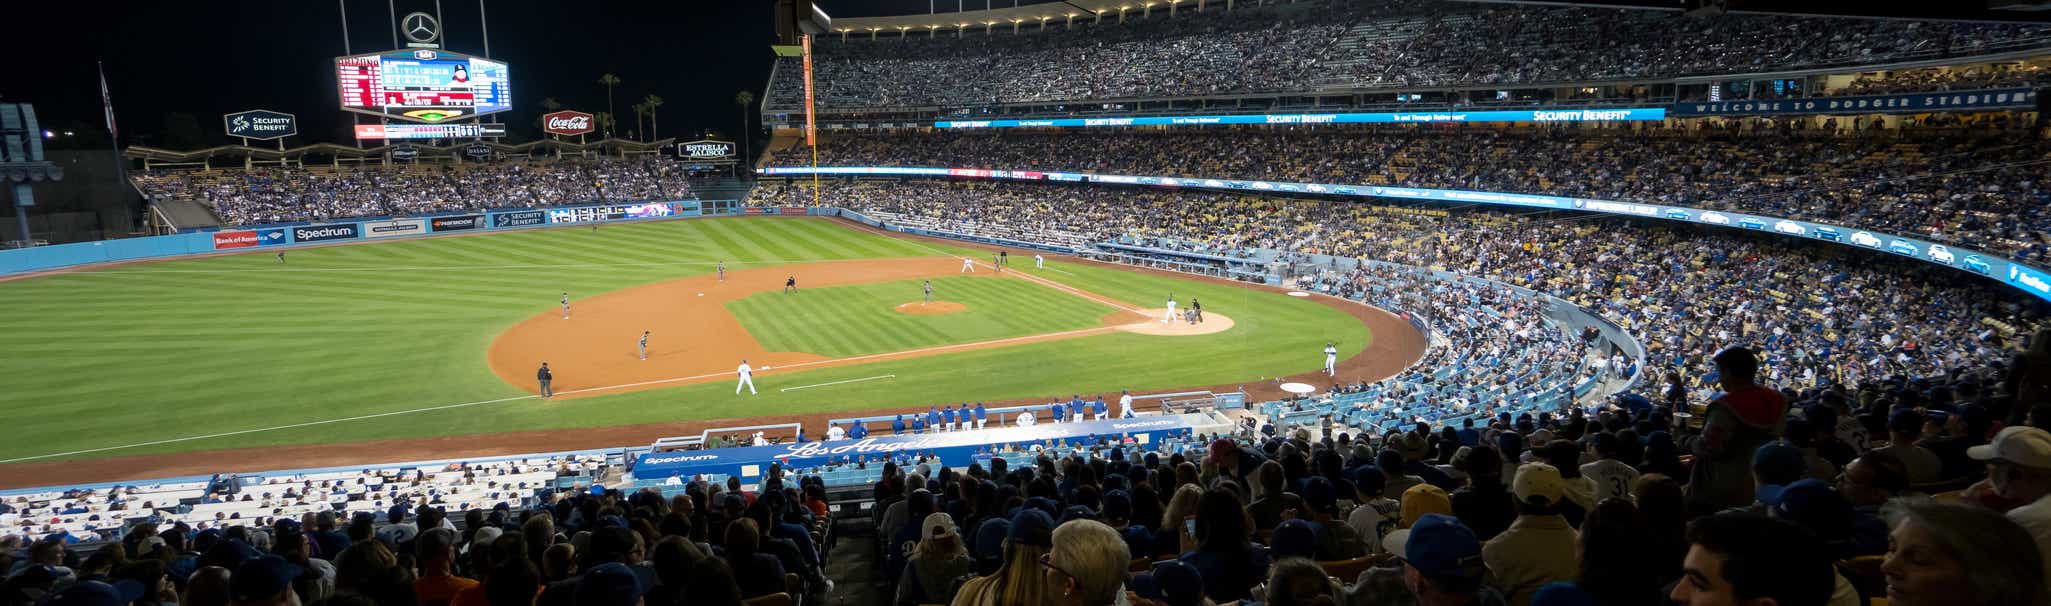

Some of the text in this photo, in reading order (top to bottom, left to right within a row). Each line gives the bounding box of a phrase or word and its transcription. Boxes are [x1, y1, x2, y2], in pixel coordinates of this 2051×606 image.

[1696, 103, 1780, 112] WELCOME
[1830, 98, 1909, 109] DODGER
[1925, 92, 2026, 106] STADIUM
[1266, 115, 1300, 123] SECURITY
[1533, 110, 1583, 121] SECURITY
[548, 116, 590, 130] Coca-Cola
[511, 212, 542, 220] SECURITY
[297, 227, 351, 240] Spectrum
[775, 442, 828, 458] Los
[644, 455, 714, 465] Spectrum
[1609, 476, 1628, 496] 31
